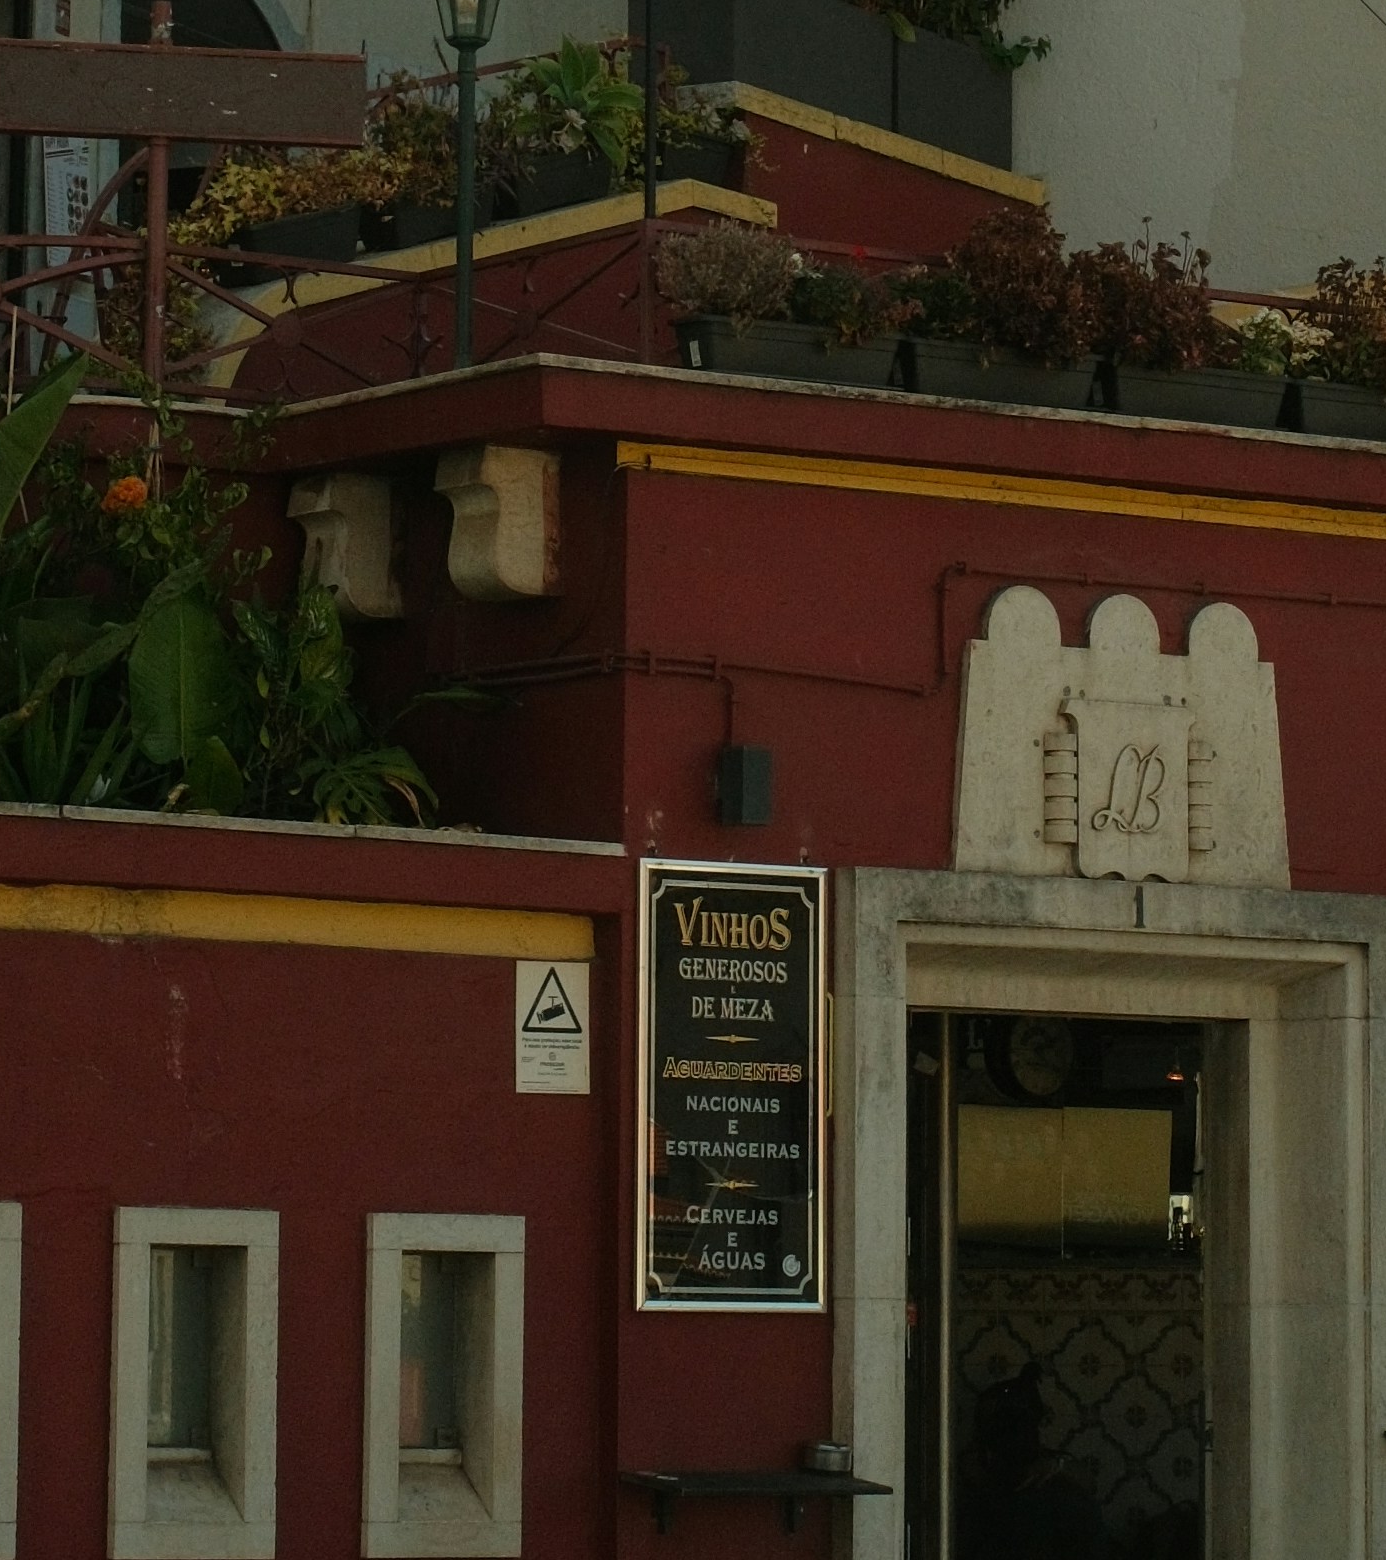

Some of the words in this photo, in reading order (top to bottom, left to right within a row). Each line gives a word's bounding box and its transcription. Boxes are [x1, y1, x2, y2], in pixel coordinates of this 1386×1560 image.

[1133, 885, 1146, 929] 1
[673, 895, 792, 951] VINHOS
[678, 957, 789, 985] GENEROSOS
[691, 996, 716, 1020] DE
[720, 996, 775, 1022] MEZA
[662, 1055, 803, 1083] AGUARDENTES
[685, 1095, 781, 1115] NACIONAIS
[728, 1119, 739, 1135] E
[665, 1140, 801, 1161] ESTRANGEIRAS
[686, 1204, 779, 1227] CERVEJAS
[727, 1231, 739, 1248] E
[698, 1243, 766, 1271] ÁGUAS
